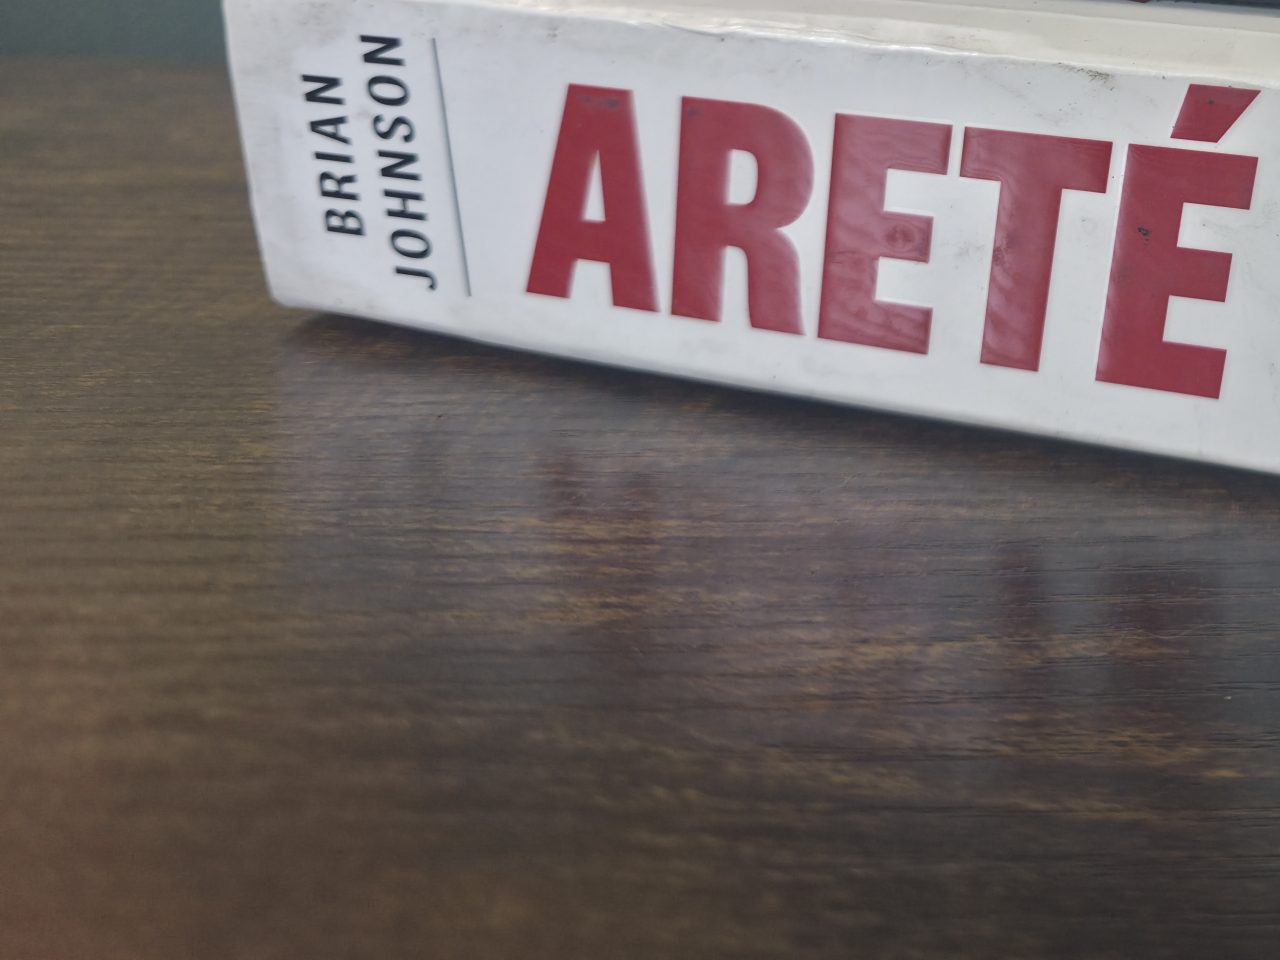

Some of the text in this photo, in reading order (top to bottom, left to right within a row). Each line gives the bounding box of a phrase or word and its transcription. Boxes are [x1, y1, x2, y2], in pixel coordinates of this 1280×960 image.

[301, 74, 366, 236] BRIAN
[359, 35, 437, 291] JOHNSON
[525, 83, 1262, 400] ARETÉ
